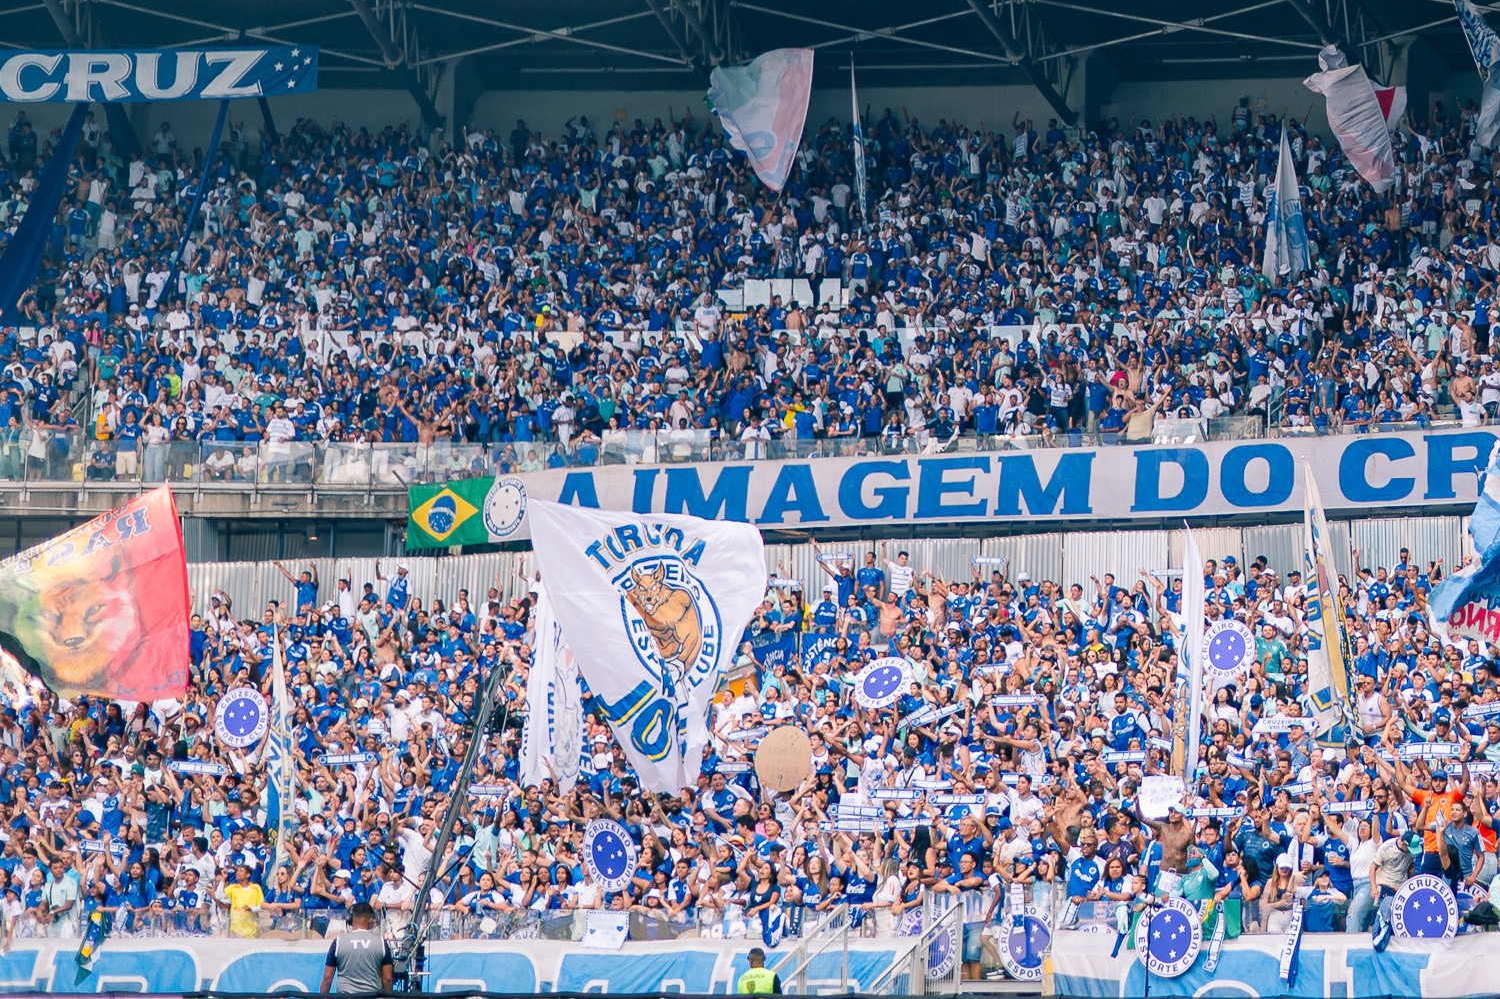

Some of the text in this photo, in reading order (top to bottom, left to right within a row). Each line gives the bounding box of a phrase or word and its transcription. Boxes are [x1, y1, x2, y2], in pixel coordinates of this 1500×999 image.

[0, 49, 268, 102] CRUZ
[632, 452, 1096, 524] IMAGEM
[1130, 442, 1295, 513] DO
[1203, 622, 1234, 660] CRUZEIRO
[1240, 626, 1253, 657] CLUBE
[221, 691, 262, 709] CRUZEIRO
[217, 711, 265, 744] ESPORTE CLUBE
[589, 822, 631, 847] CRUZEIRO
[585, 844, 634, 888] ESPORTE CLUBE
[1408, 879, 1455, 916] CRUZEIRO
[1394, 894, 1408, 939] ESPOR
[350, 939, 371, 950] TV
[1182, 923, 1199, 965] CLUBE
[1007, 960, 1042, 978] ESPOR
